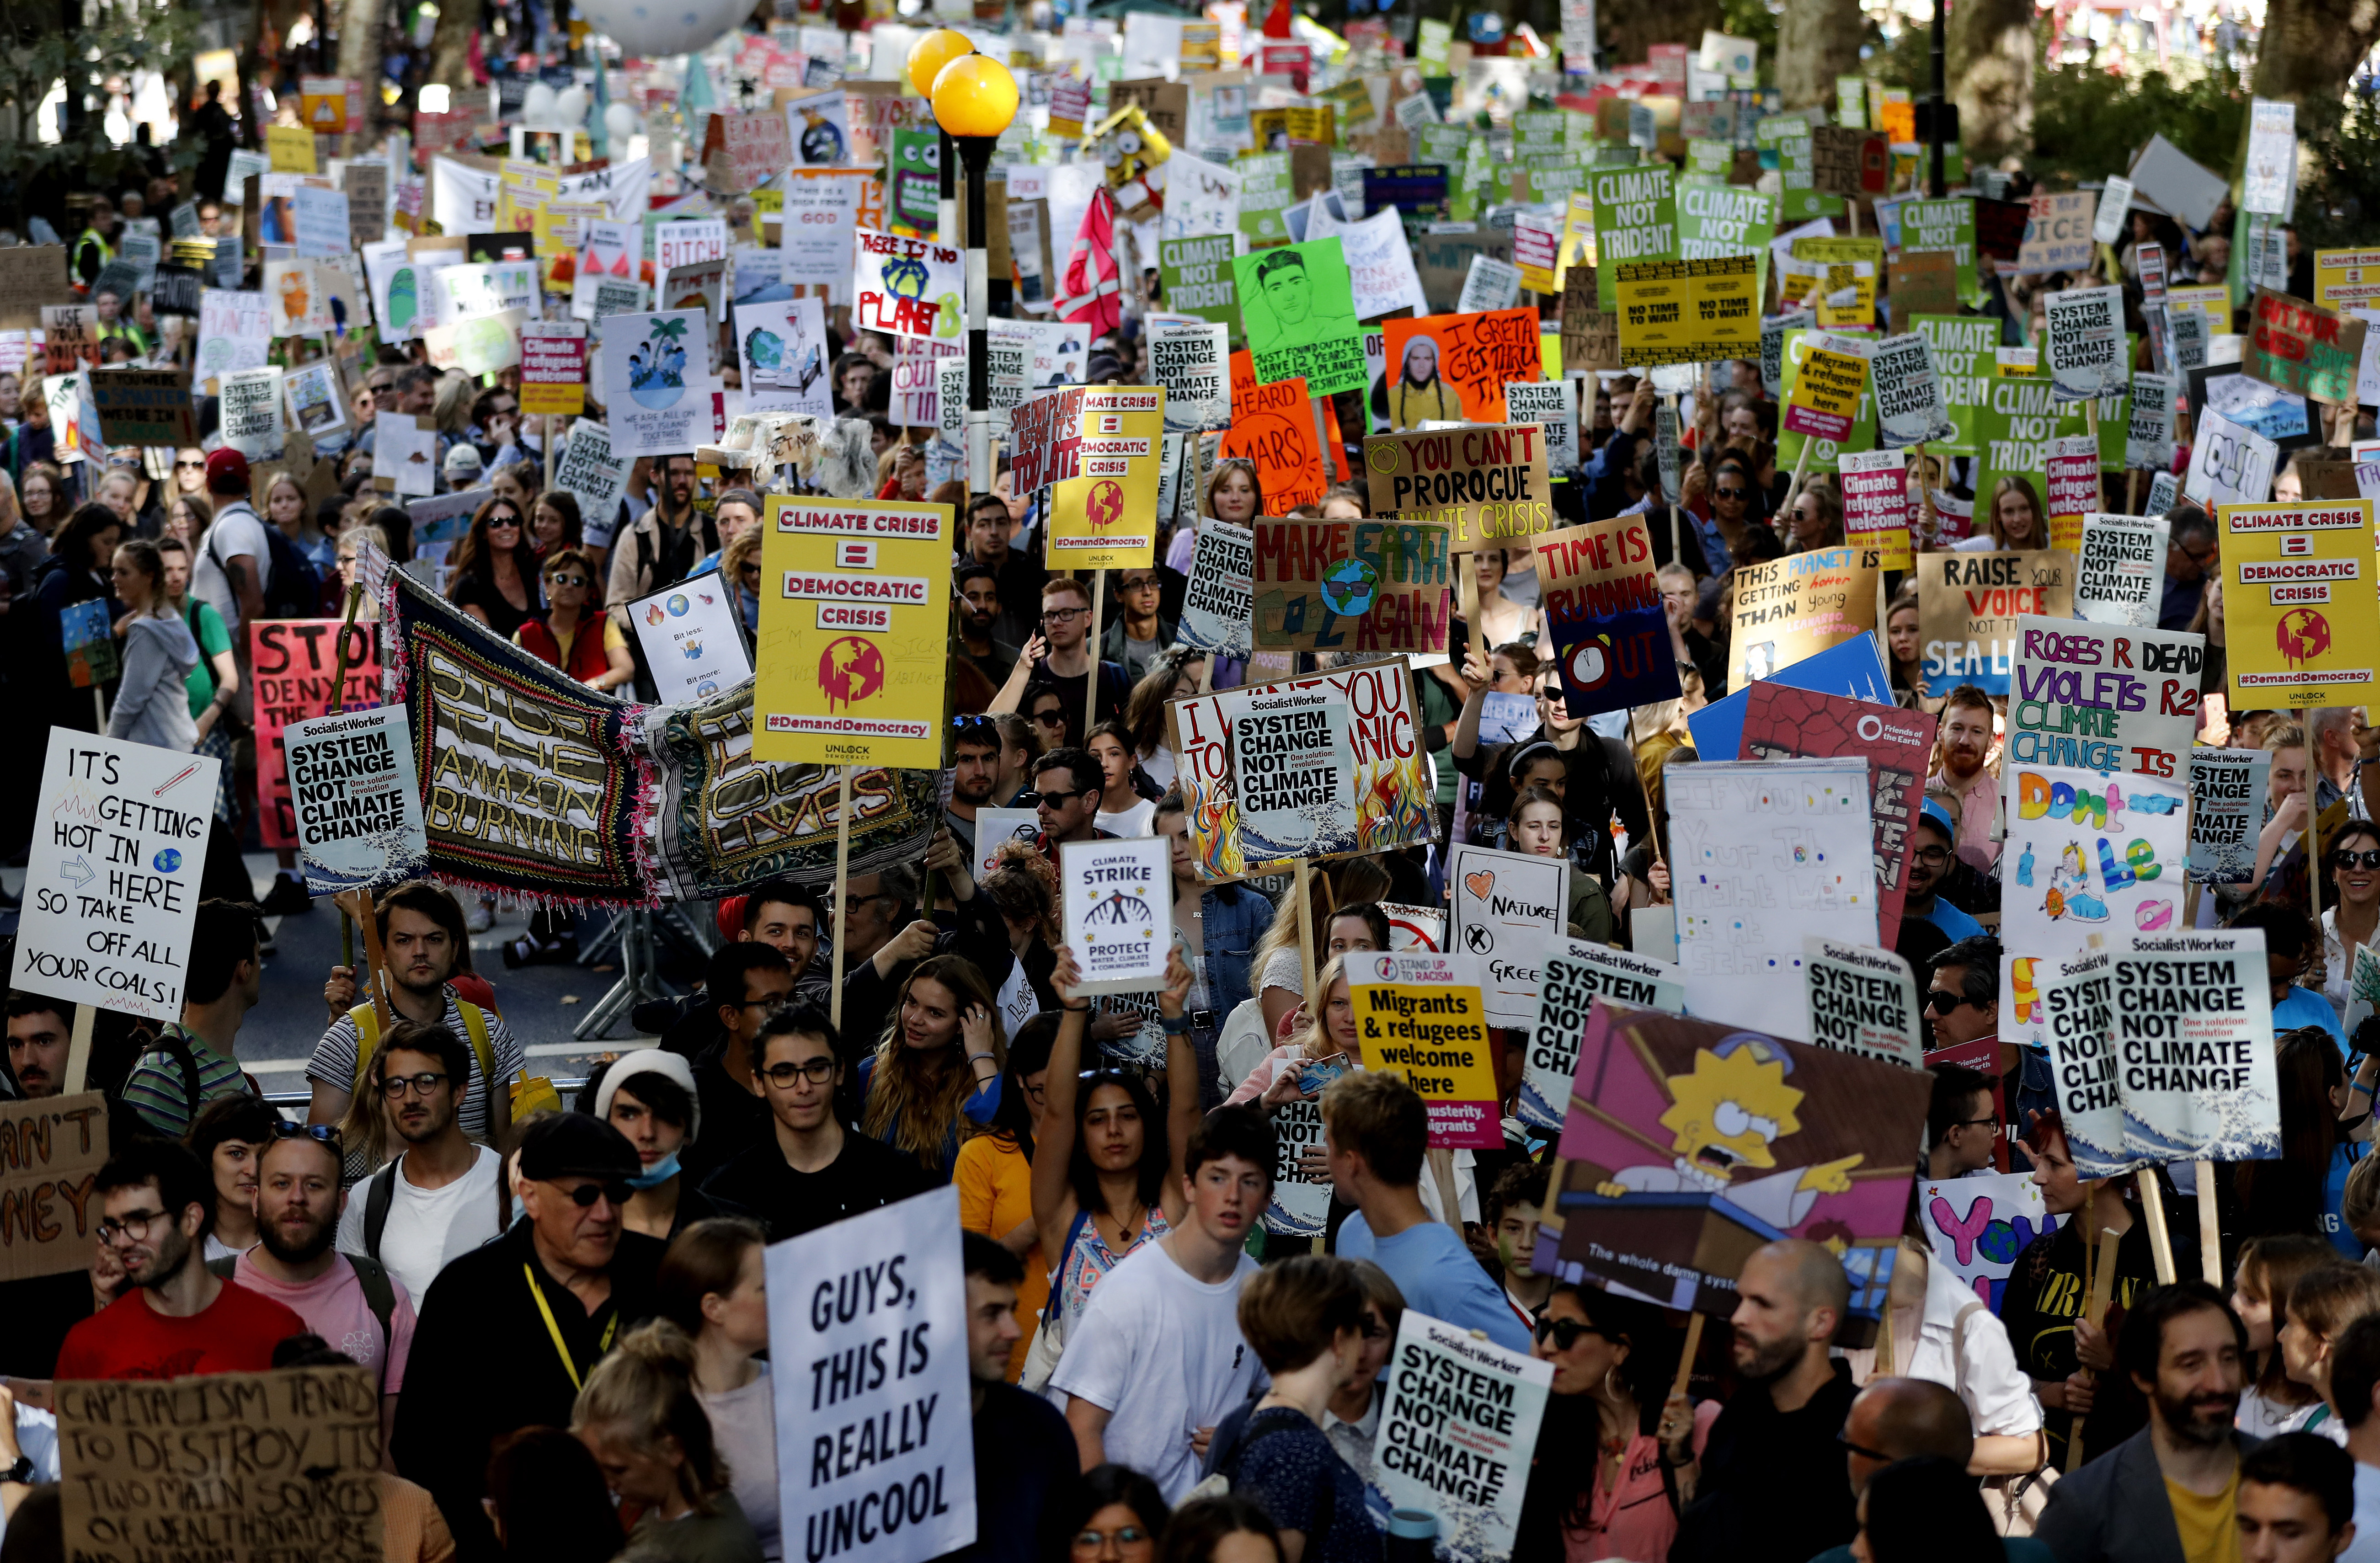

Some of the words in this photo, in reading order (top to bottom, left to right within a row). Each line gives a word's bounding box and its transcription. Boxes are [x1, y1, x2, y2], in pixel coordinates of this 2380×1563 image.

[1596, 170, 1671, 206] CLIMATE
[1616, 202, 1657, 227] NOT
[860, 233, 899, 256] THERE
[903, 235, 927, 258] IS
[932, 246, 956, 263] NO
[1163, 237, 1231, 265] CLIMATE
[1601, 224, 1673, 261] TRIDENT
[1181, 263, 1217, 283] NOT
[1168, 281, 1232, 309] TRIDENT
[859, 292, 940, 336] PLANET
[937, 292, 961, 338] B
[1628, 306, 1644, 315] NO
[1648, 304, 1679, 314] TIME
[1629, 316, 1644, 325] TO
[1646, 313, 1679, 324] WAIT
[524, 340, 575, 354] Climate
[1443, 322, 1466, 354] I
[1474, 315, 1534, 346] GRETA
[523, 355, 583, 371] refugees
[523, 368, 582, 383] welcome
[1448, 348, 1495, 381] GET
[1491, 343, 1539, 370] THRU
[1011, 405, 1031, 433] SAVE
[1031, 396, 1050, 426] OUR
[1048, 388, 1085, 420] PLANET
[1121, 397, 1157, 407] CRISIS
[1052, 415, 1077, 441] IT'S
[1403, 437, 1452, 473] YOU
[1463, 427, 1538, 467] CAN'T
[1012, 448, 1041, 496] TOO
[1089, 462, 1126, 472] CRISIS
[1394, 466, 1532, 508] PROROGUE
[1844, 475, 1898, 494] Climate
[1846, 494, 1905, 513] refugees
[780, 511, 868, 530] CLIMATE
[874, 517, 939, 533] CRISIS
[1478, 502, 1548, 539] CRISIS
[1848, 515, 1906, 532] welcome
[2231, 512, 2304, 528] CLIMATE
[2307, 512, 2362, 525] CRISIS
[1057, 537, 1147, 547] #DemandDemocracy
[1256, 523, 1350, 582] MAKE
[1355, 524, 1448, 584] EARTH
[1537, 533, 1612, 580] TIME
[1617, 526, 1648, 566] IS
[1944, 557, 2021, 587] RAISE
[2033, 569, 2061, 585] YOUR
[2244, 563, 2356, 579] DEMOCRATIC
[789, 577, 923, 599] DEMOCRATIC
[1546, 572, 1659, 625] RUNNING
[1964, 586, 2048, 617] VOICE
[2274, 587, 2327, 600] CRISIS
[822, 608, 886, 625] CRISIS
[1255, 588, 1346, 646] COOL
[1356, 589, 1451, 651] AGAIN
[1737, 600, 1796, 628] THAN
[1808, 593, 1845, 613] young
[685, 627, 704, 637] less:
[1969, 620, 1995, 634] NOT
[1926, 640, 1984, 677] SEA
[2025, 629, 2104, 666] ROSES
[2113, 638, 2134, 669] R
[2143, 641, 2202, 674] DEAD
[686, 677, 698, 685] Bit
[699, 669, 721, 681] more:
[2017, 665, 2147, 711] VIOLETS
[2161, 679, 2198, 716] R2
[2241, 670, 2370, 684] #DemandDemocracy
[428, 650, 588, 741] STOP
[769, 716, 927, 736] #DemandDemocracy
[1238, 710, 1328, 736] SYSTEM
[1884, 725, 1910, 735] Friends
[2016, 700, 2120, 739] CLIMATE
[291, 732, 388, 766] SYSTEM
[434, 702, 602, 785] THE
[826, 744, 870, 754] UNLOCK
[1240, 730, 1333, 756] CHANGE
[1883, 732, 1897, 741] the
[1899, 735, 1920, 747] Earth
[69, 748, 120, 784] IT'S
[294, 750, 396, 785] CHANGE
[1242, 753, 1288, 774] NOT
[1304, 750, 1335, 760] solution:
[1291, 758, 1324, 768] revolution
[2011, 731, 2122, 772] CHANGE
[2131, 747, 2176, 778] IS
[298, 779, 347, 806] NOT
[350, 779, 365, 789] One
[367, 773, 399, 785] solution:
[351, 783, 390, 795] revolution
[434, 745, 601, 821] AMAZON
[1243, 767, 1338, 794] CLIMATE
[301, 789, 404, 825] CLIMATE
[1244, 786, 1336, 812] CHANGE
[99, 795, 203, 838] GETTING
[305, 810, 405, 845] CHANGE
[427, 786, 603, 867] BURNING
[54, 822, 102, 853] HOT
[106, 834, 140, 867] IN
[1092, 856, 1137, 866] CLIMATE
[2097, 837, 2162, 893] be
[1083, 867, 1151, 885] STRIKE
[110, 870, 184, 914] HERE
[37, 888, 67, 914] SO
[77, 895, 134, 924] TAKE
[1492, 895, 1558, 921] NATURE
[87, 931, 131, 956] OFF
[131, 940, 181, 968] ALL
[1089, 942, 1150, 956] PROTECT
[24, 948, 89, 981] YOUR
[95, 966, 176, 1008] COALS!
[1399, 960, 1430, 971] STAND
[1432, 961, 1446, 970] UP
[1402, 972, 1413, 981] TO
[1416, 972, 1453, 982] RACISM
[2115, 961, 2236, 987] SYSTEM
[1369, 990, 1468, 1016] Migrants
[2118, 987, 2246, 1013] CHANGE
[1365, 1018, 1381, 1038] &
[1388, 1019, 1481, 1045] refugees
[2120, 1015, 2177, 1039] NOT
[1380, 1047, 1473, 1067] welcome
[2124, 1041, 2252, 1065] CLIMATE
[2125, 1067, 2251, 1093] CHANGE
[1589, 1243, 1614, 1260] The
[1618, 1251, 1660, 1273] whole
[1663, 1263, 1700, 1282] damn
[811, 1254, 916, 1334] GUYS,
[809, 1338, 887, 1411] THIS
[897, 1322, 930, 1381] IS
[810, 1393, 939, 1488] REALLY
[806, 1465, 948, 1563] UNCOOL
